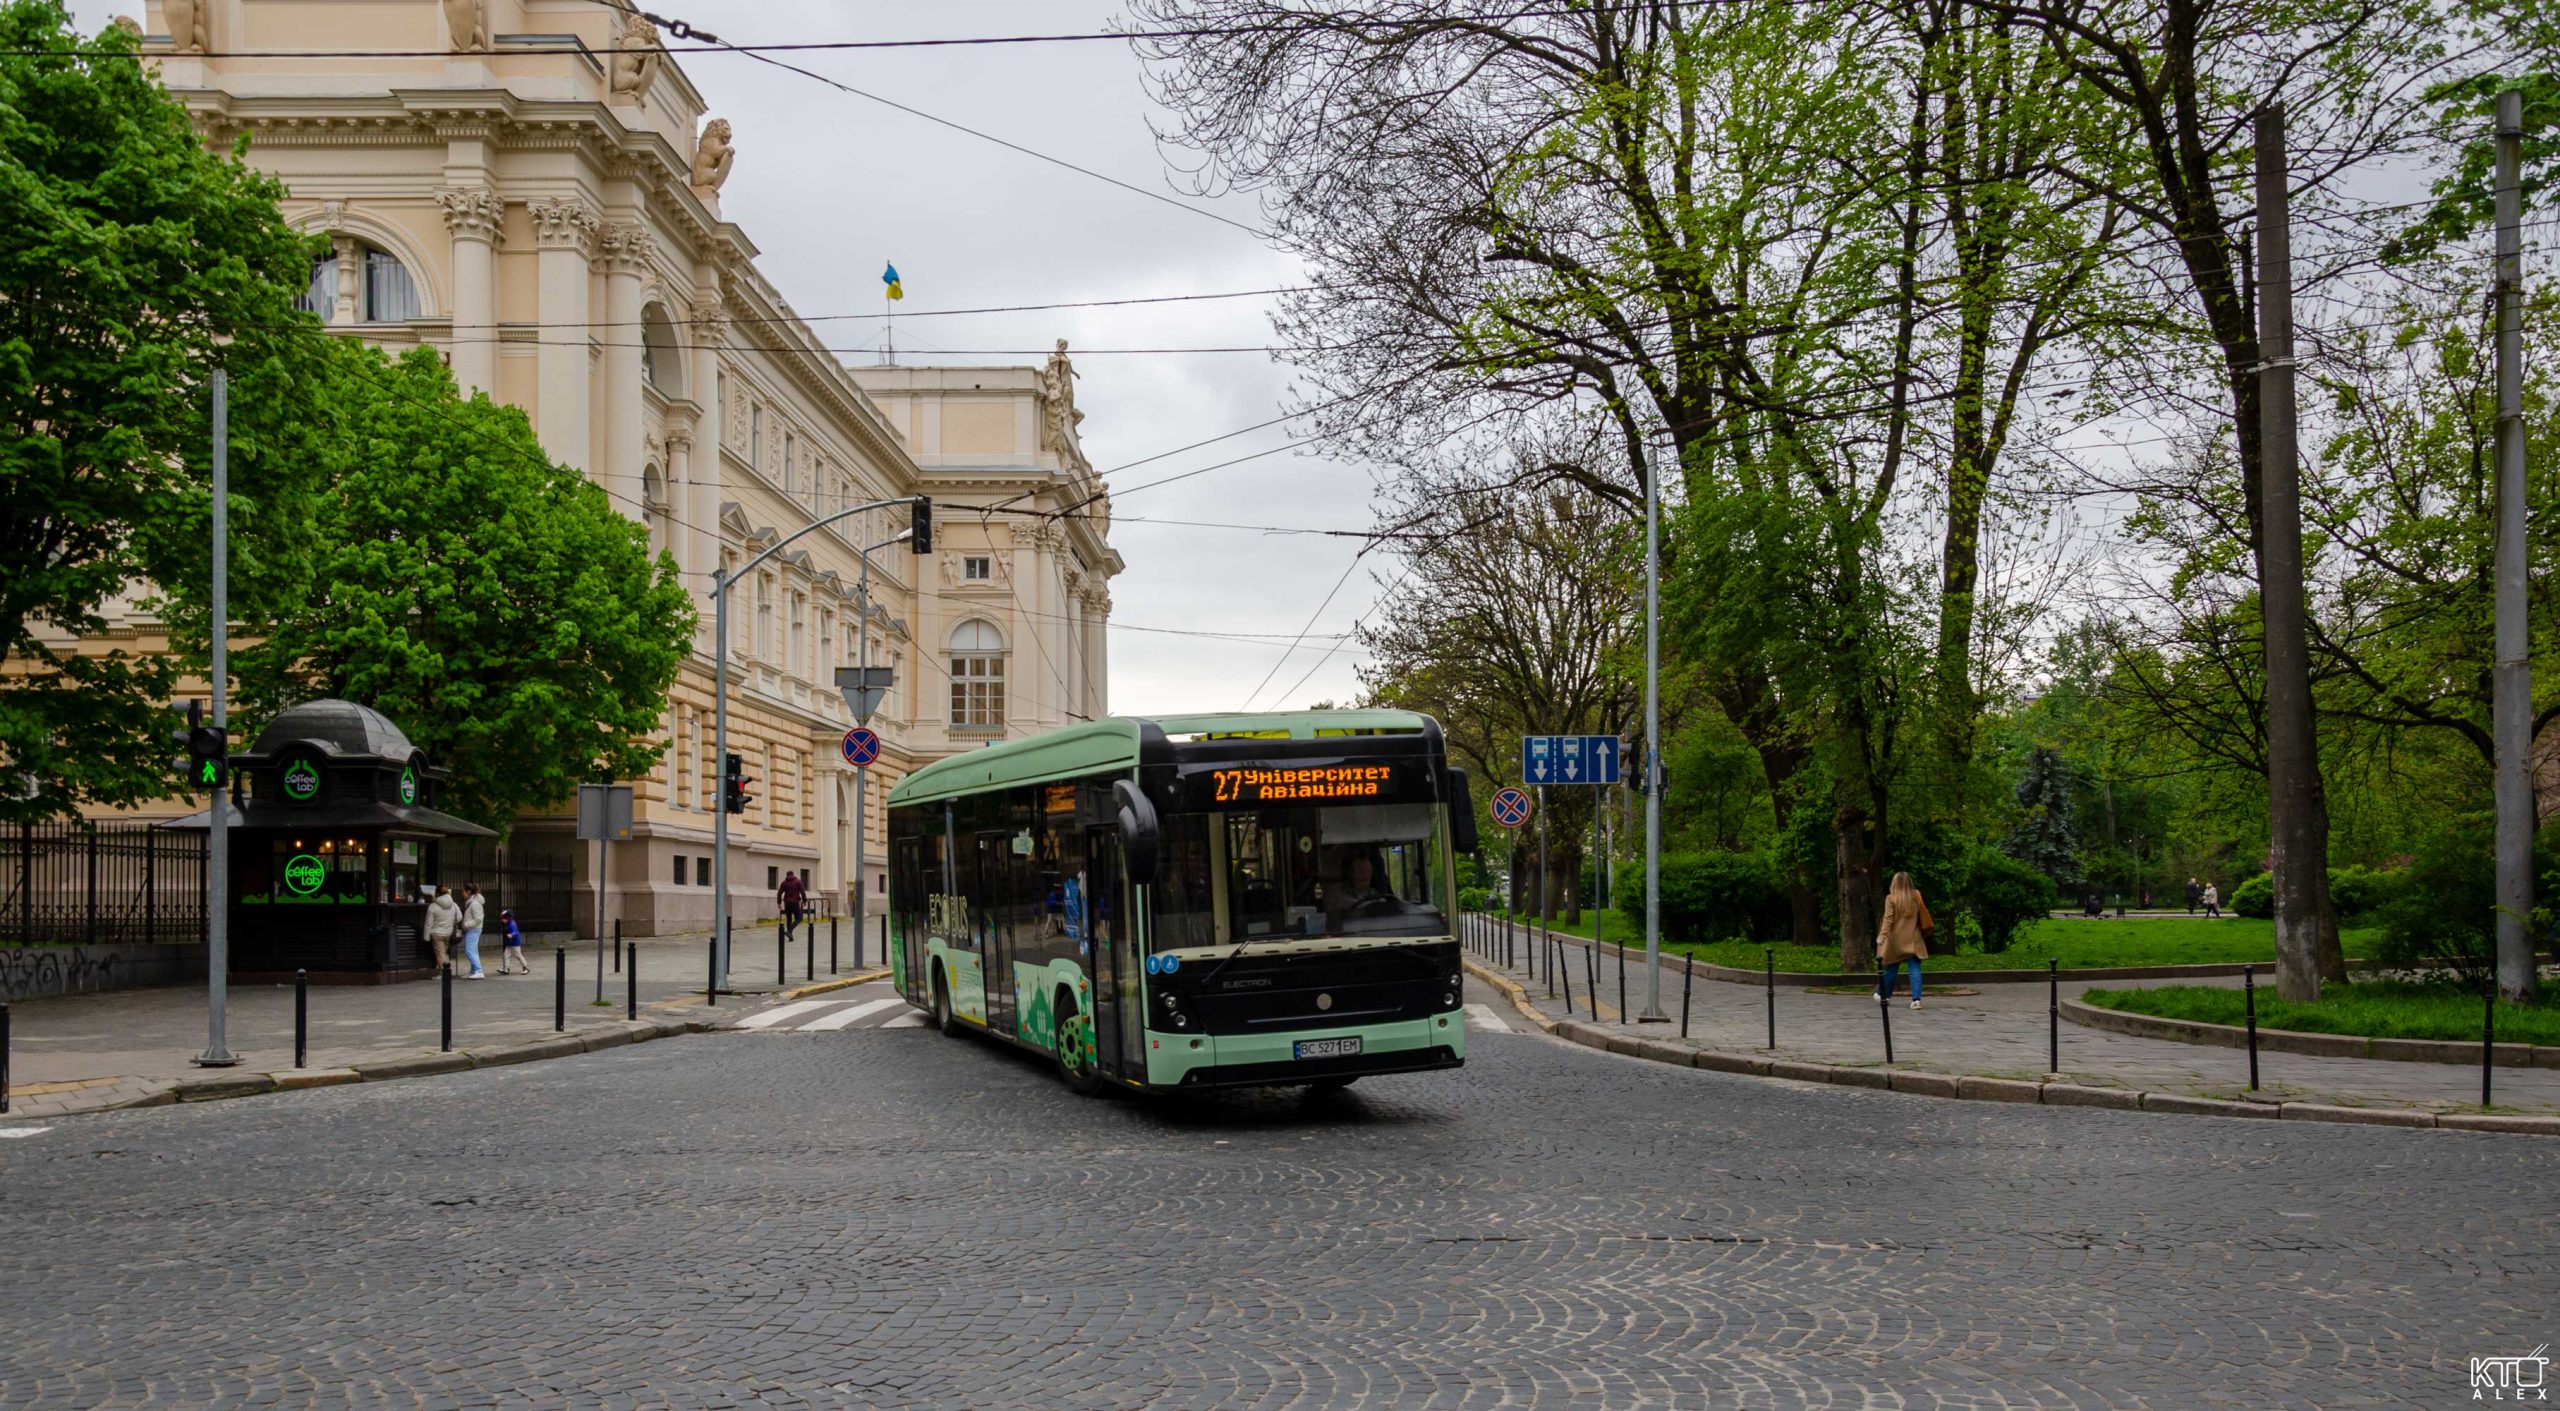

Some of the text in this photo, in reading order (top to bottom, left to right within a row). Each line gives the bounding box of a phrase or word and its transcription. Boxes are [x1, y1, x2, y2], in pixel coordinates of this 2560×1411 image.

[285, 773, 316, 784] coffee
[1213, 766, 1390, 801] 27 Університет
[1260, 782, 1378, 800] Авіаційна
[287, 865, 322, 877] coffee
[1222, 978, 1272, 989] ELECTRON
[1301, 1044, 1316, 1055] BC
[1343, 1040, 1357, 1052] EM
